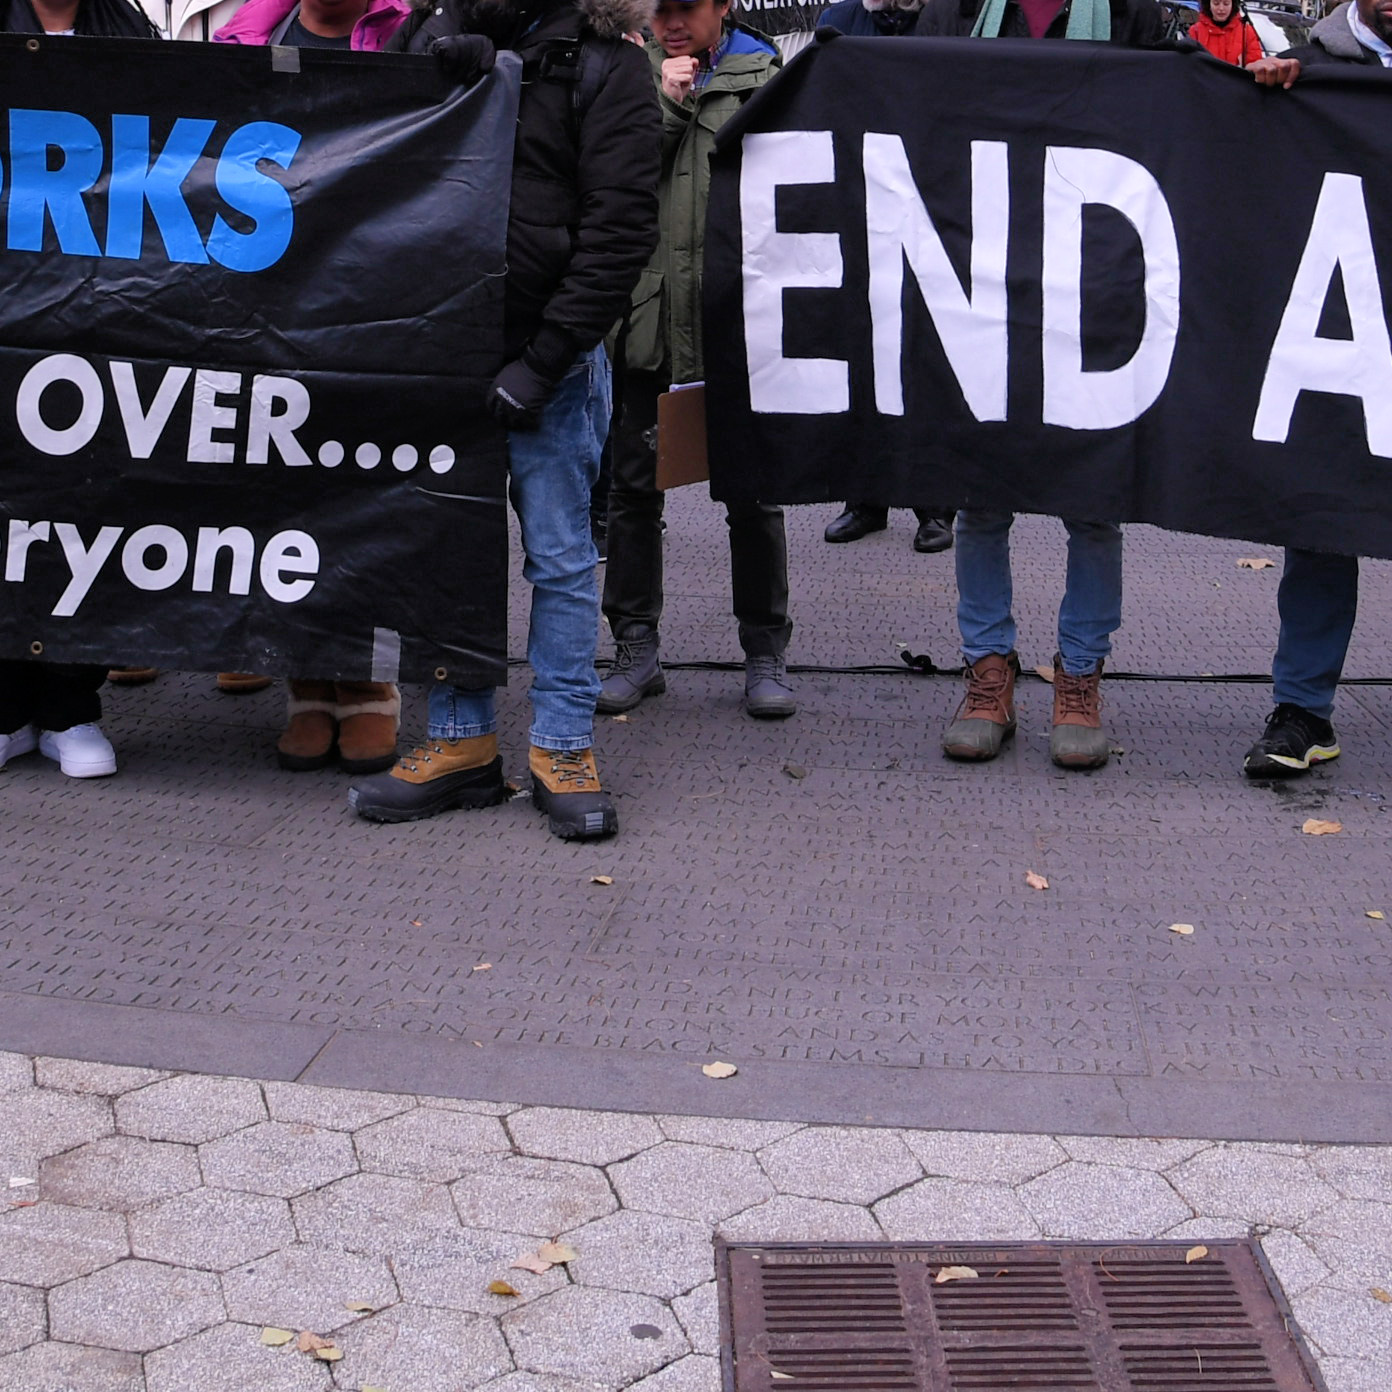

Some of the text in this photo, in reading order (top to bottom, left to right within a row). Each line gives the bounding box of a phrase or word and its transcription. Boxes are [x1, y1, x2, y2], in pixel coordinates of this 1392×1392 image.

[741, 130, 1182, 432] END
[15, 353, 456, 475] OVER....
[8, 958, 82, 975] THE
[486, 1008, 537, 1021] OF
[776, 1026, 879, 1042] AND
[897, 1030, 944, 1046] AS
[962, 1033, 1025, 1048] TO
[1041, 1036, 1133, 1051] YOU
[23, 980, 115, 999] AND
[401, 1019, 471, 1036] ON
[494, 1027, 571, 1044] THE
[752, 1044, 889, 1064] STEMS
[907, 1051, 1033, 1069] THAT
[1230, 1064, 1283, 1079] IN
[1298, 1065, 1392, 1081] THE
[485, 987, 567, 1003] YOU
[748, 1004, 844, 1021] HUG
[862, 1010, 917, 1024] OF
